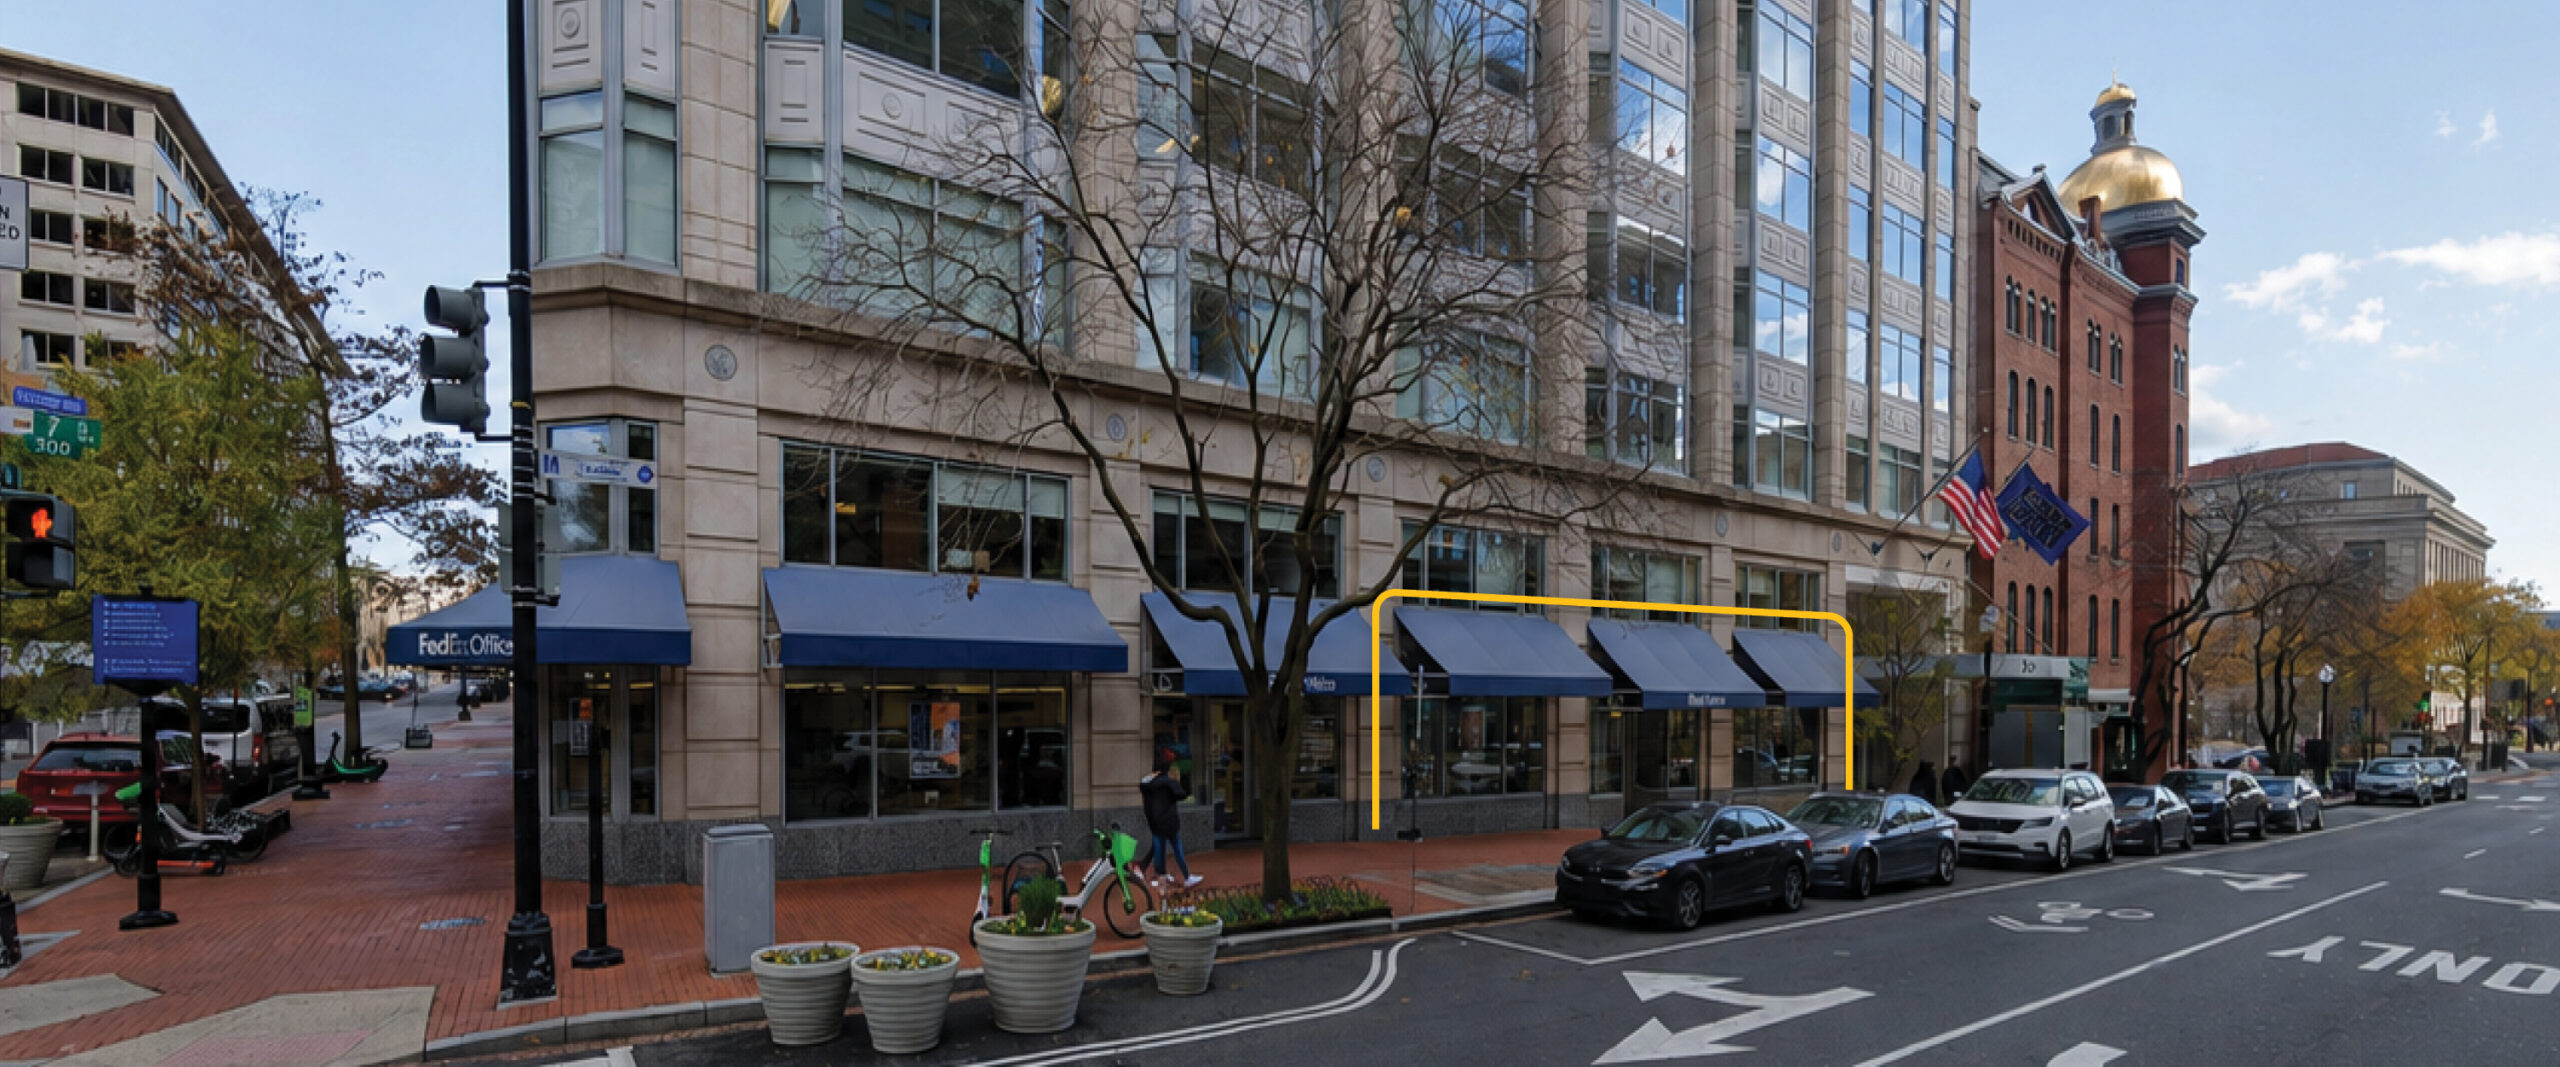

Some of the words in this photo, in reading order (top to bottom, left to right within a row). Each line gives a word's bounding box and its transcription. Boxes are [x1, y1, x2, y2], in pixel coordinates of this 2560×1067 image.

[48, 415, 60, 438] 7
[35, 438, 70, 456] 300
[2266, 935, 2560, 995] ONLY
